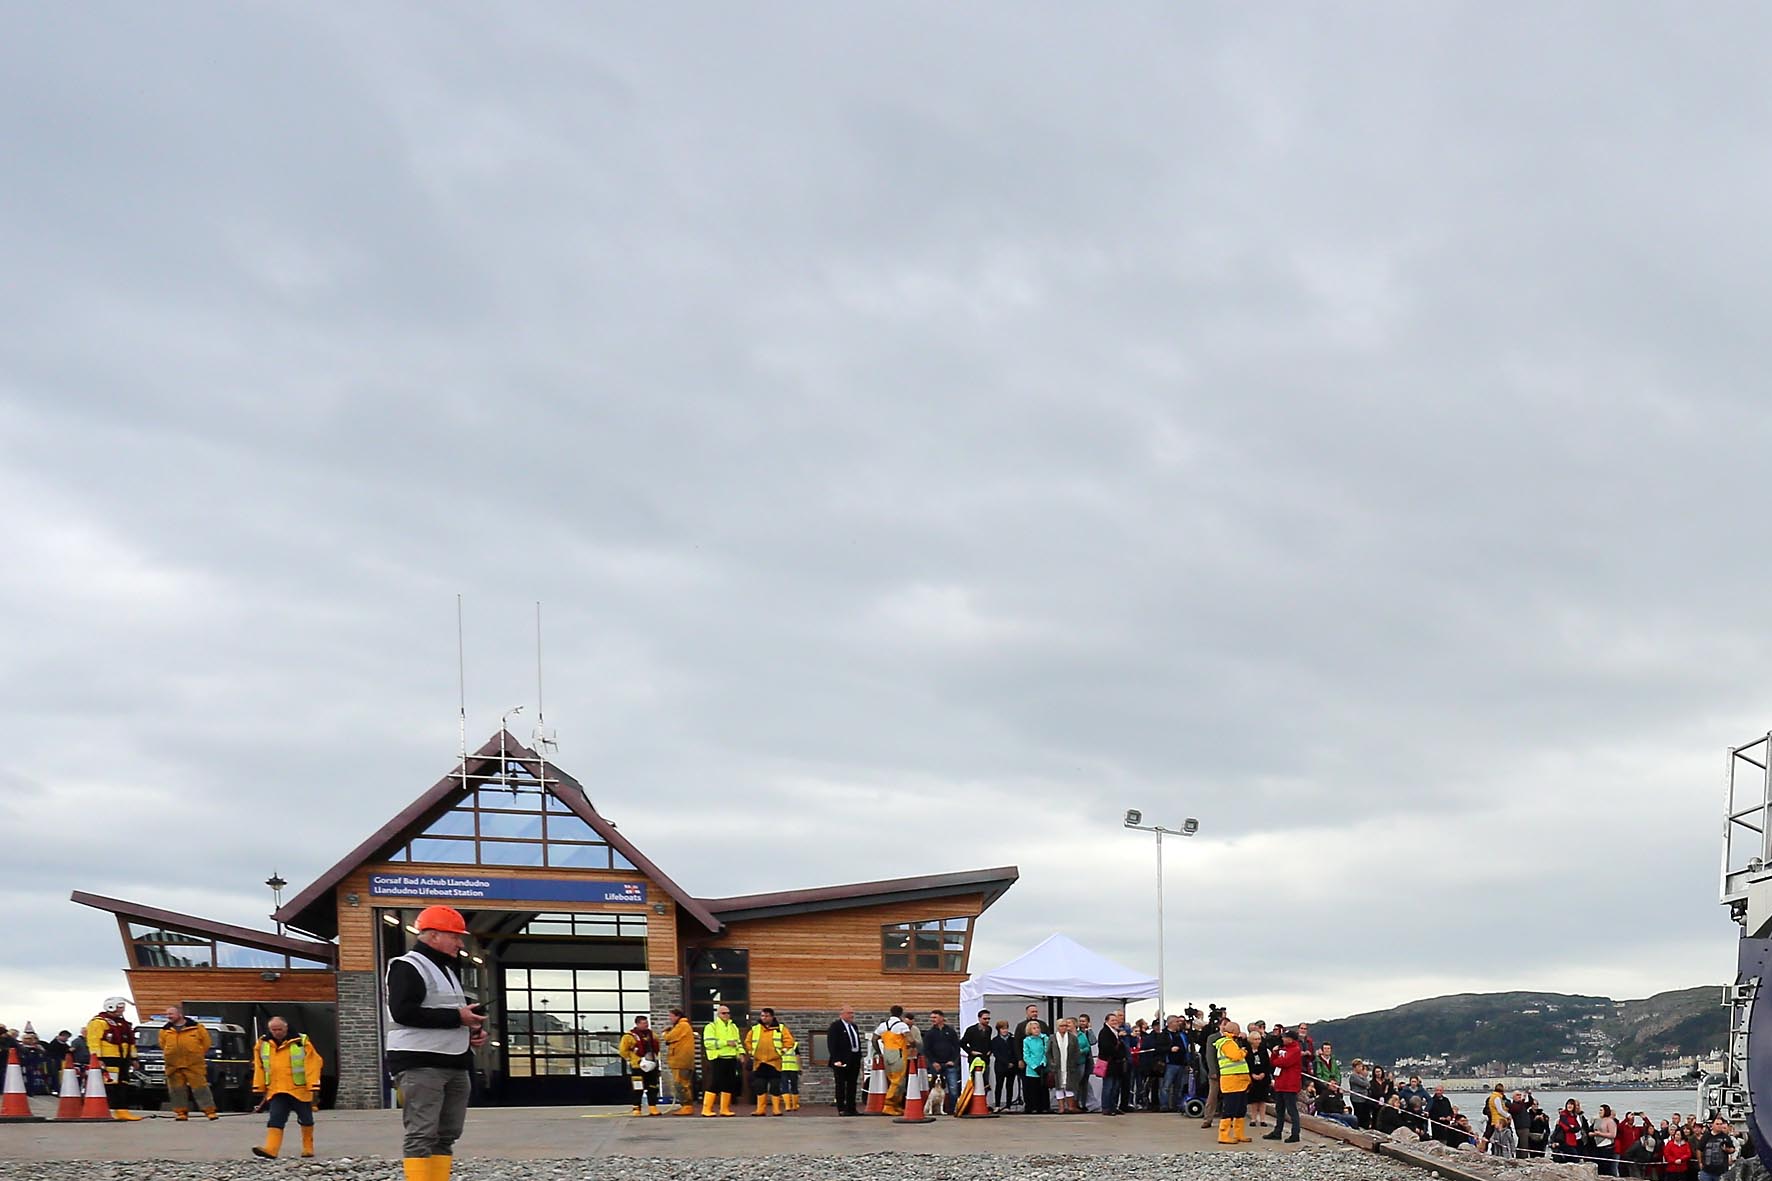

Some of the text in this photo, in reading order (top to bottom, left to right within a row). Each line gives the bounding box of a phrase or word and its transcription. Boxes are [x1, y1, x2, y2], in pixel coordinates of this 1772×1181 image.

[374, 876, 490, 887] Gorsaf Bad Achub Llandudno
[374, 887, 483, 897] Llandudno Lifeboat Station
[604, 893, 642, 901] Lifeboats
